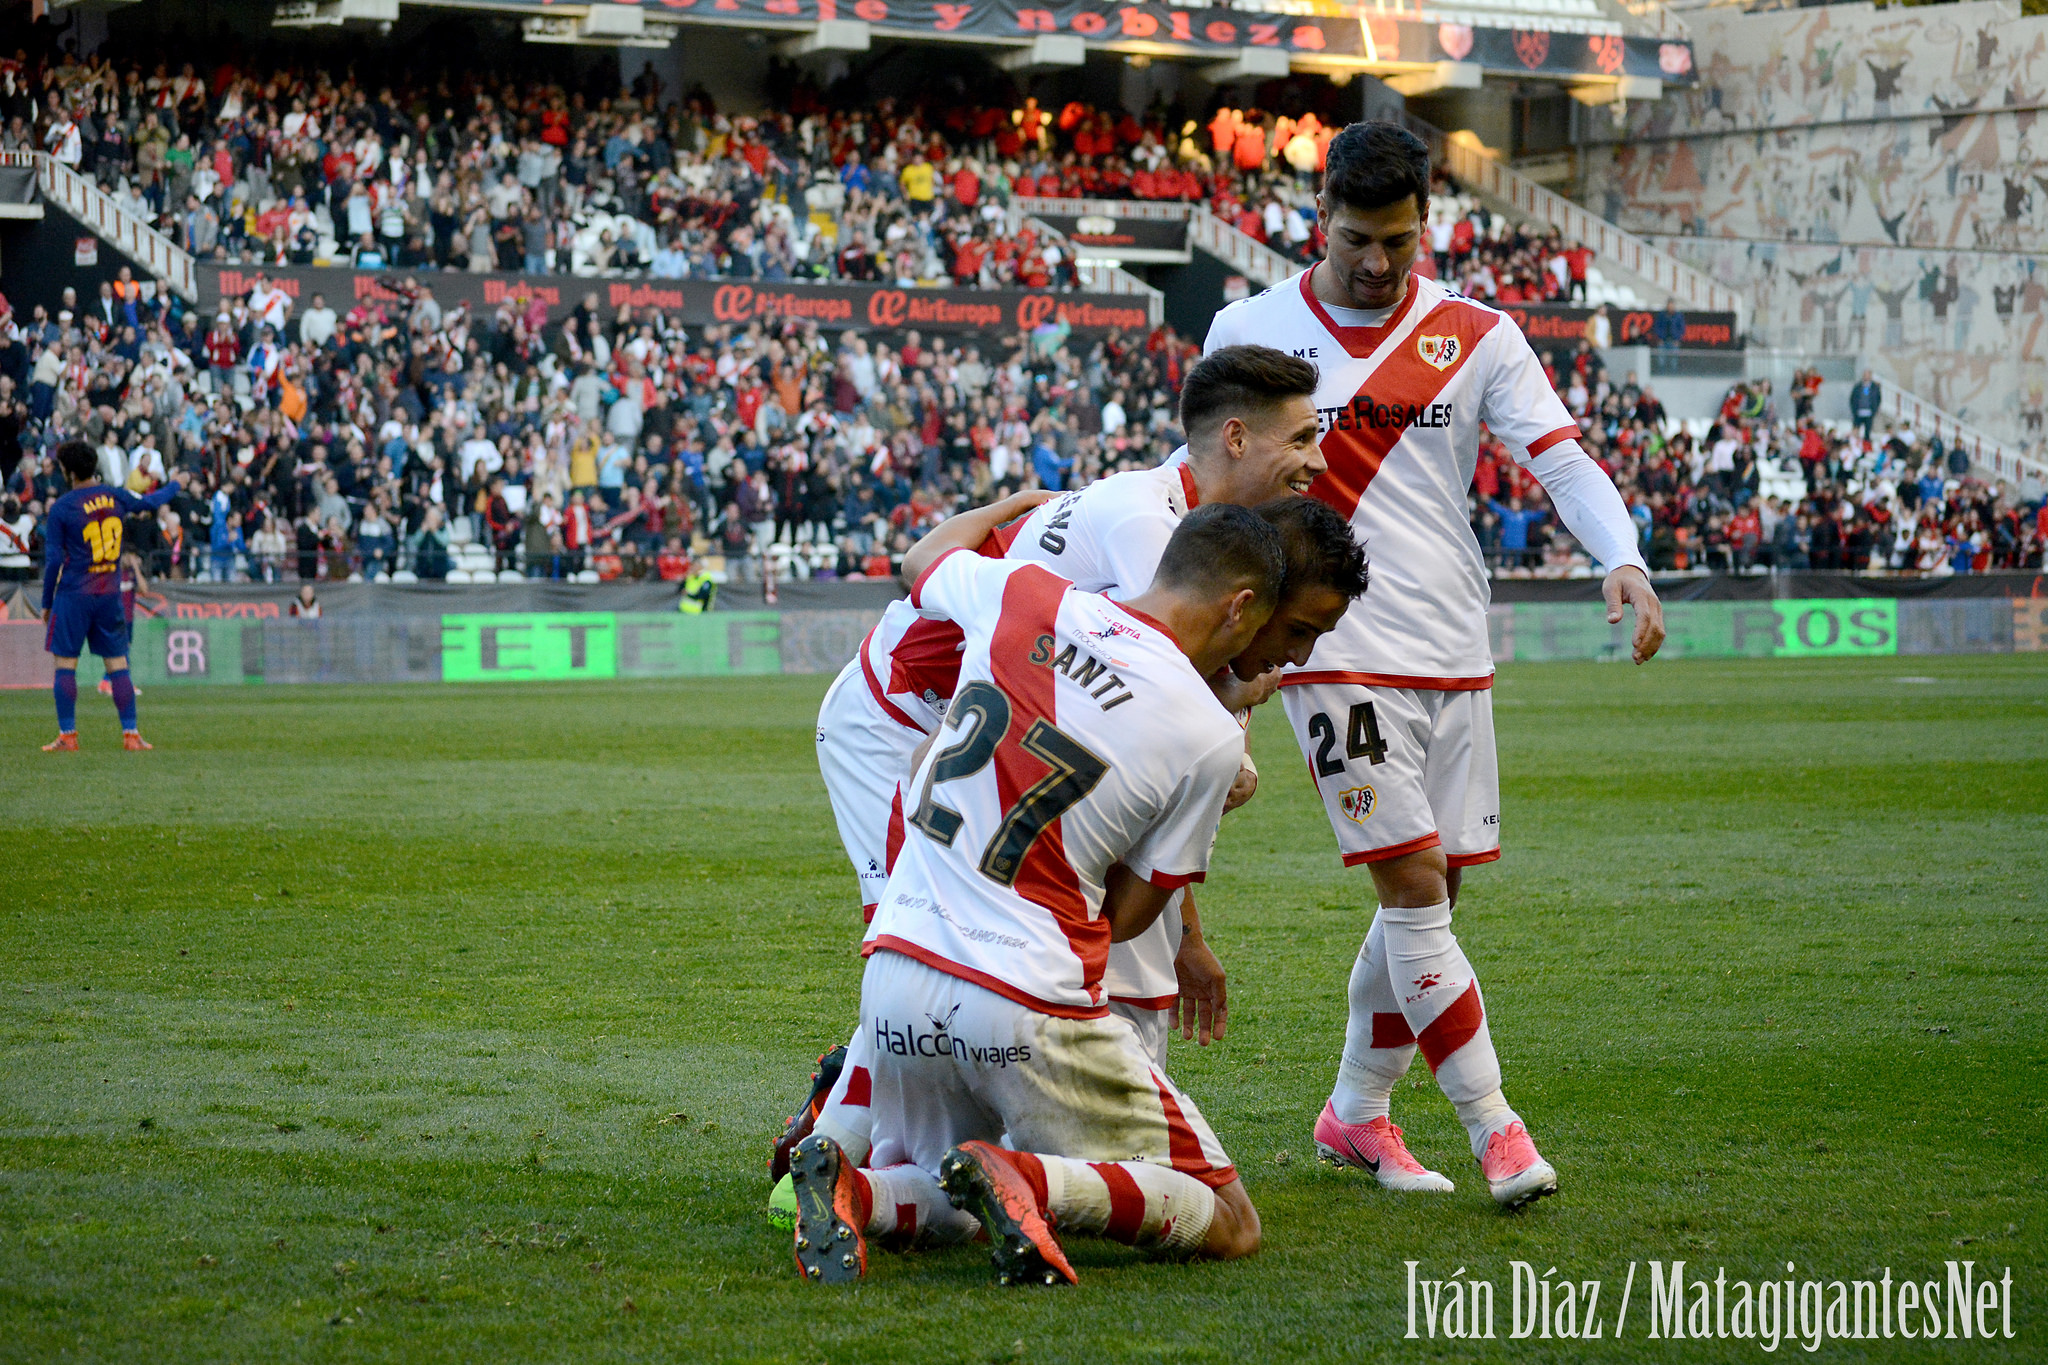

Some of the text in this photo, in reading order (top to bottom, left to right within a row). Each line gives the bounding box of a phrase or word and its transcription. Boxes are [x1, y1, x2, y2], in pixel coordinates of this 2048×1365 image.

[933, 3, 972, 31] y
[1015, 7, 1327, 51] nobleza
[82, 515, 123, 564] 10
[1028, 633, 1134, 712] SANTI
[1308, 701, 1389, 779] 24
[907, 679, 1111, 889] 27
[970, 1045, 1032, 1069] viajes
